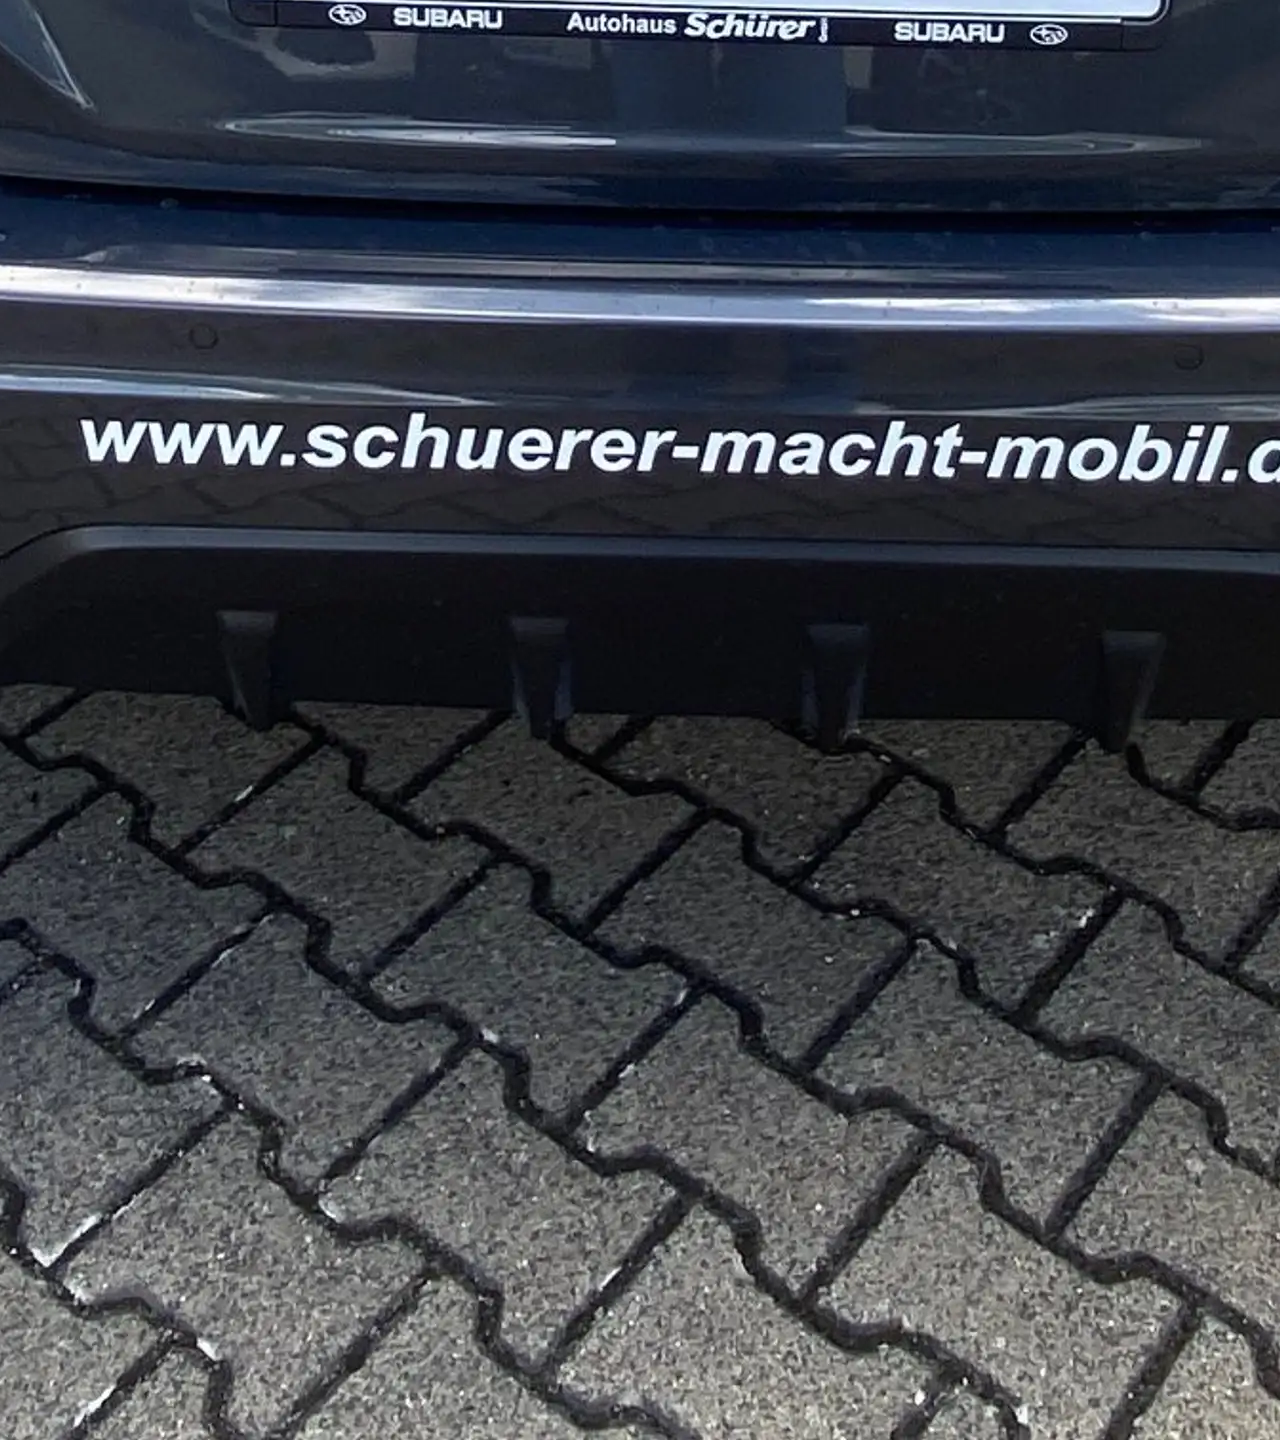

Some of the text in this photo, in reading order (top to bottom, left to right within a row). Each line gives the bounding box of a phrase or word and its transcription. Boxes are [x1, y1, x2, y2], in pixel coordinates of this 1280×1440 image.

[393, 7, 502, 29] SUBARU
[566, 11, 677, 34] Autohaus
[683, 12, 816, 40] Schürer
[894, 20, 1005, 43] SUBARU
